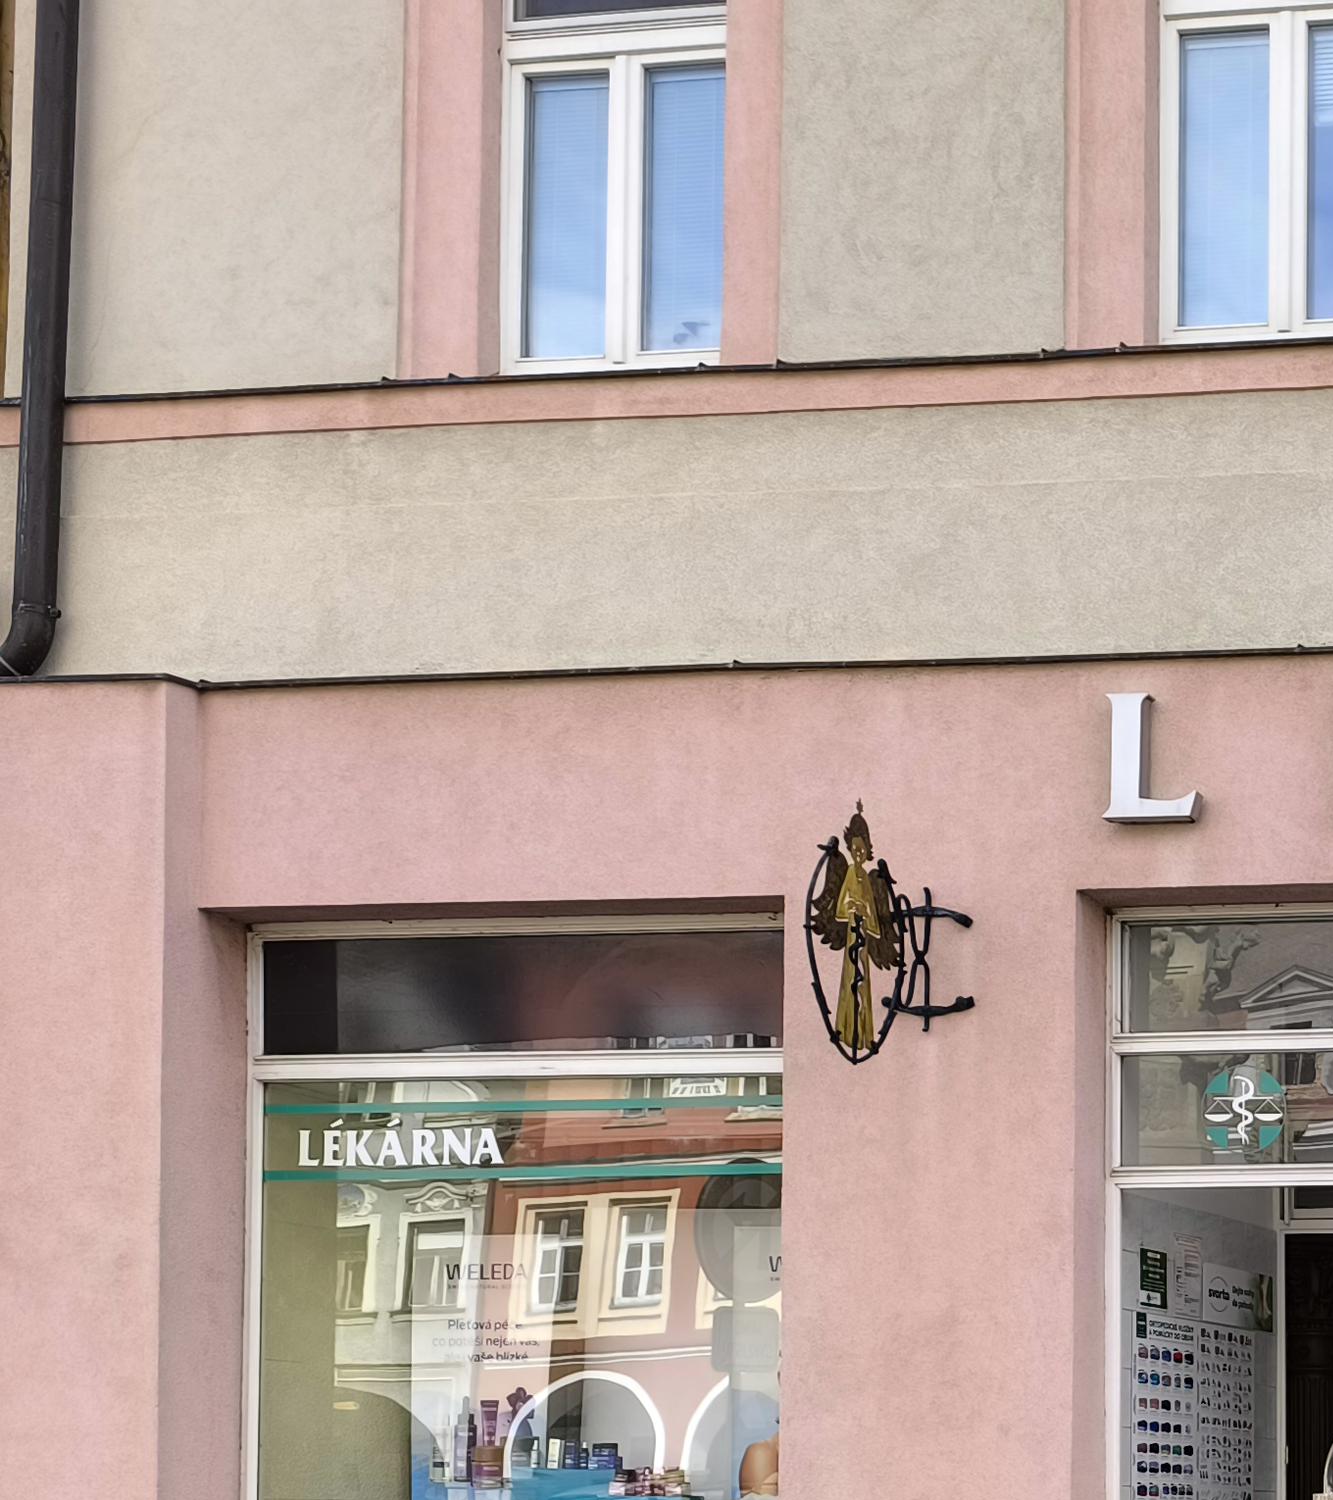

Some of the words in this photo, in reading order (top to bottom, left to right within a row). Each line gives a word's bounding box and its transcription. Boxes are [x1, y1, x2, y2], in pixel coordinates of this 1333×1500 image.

[298, 1118, 505, 1167] LÉKÁRNA
[446, 1263, 528, 1281] WELEDA
[494, 1319, 522, 1332] pée
